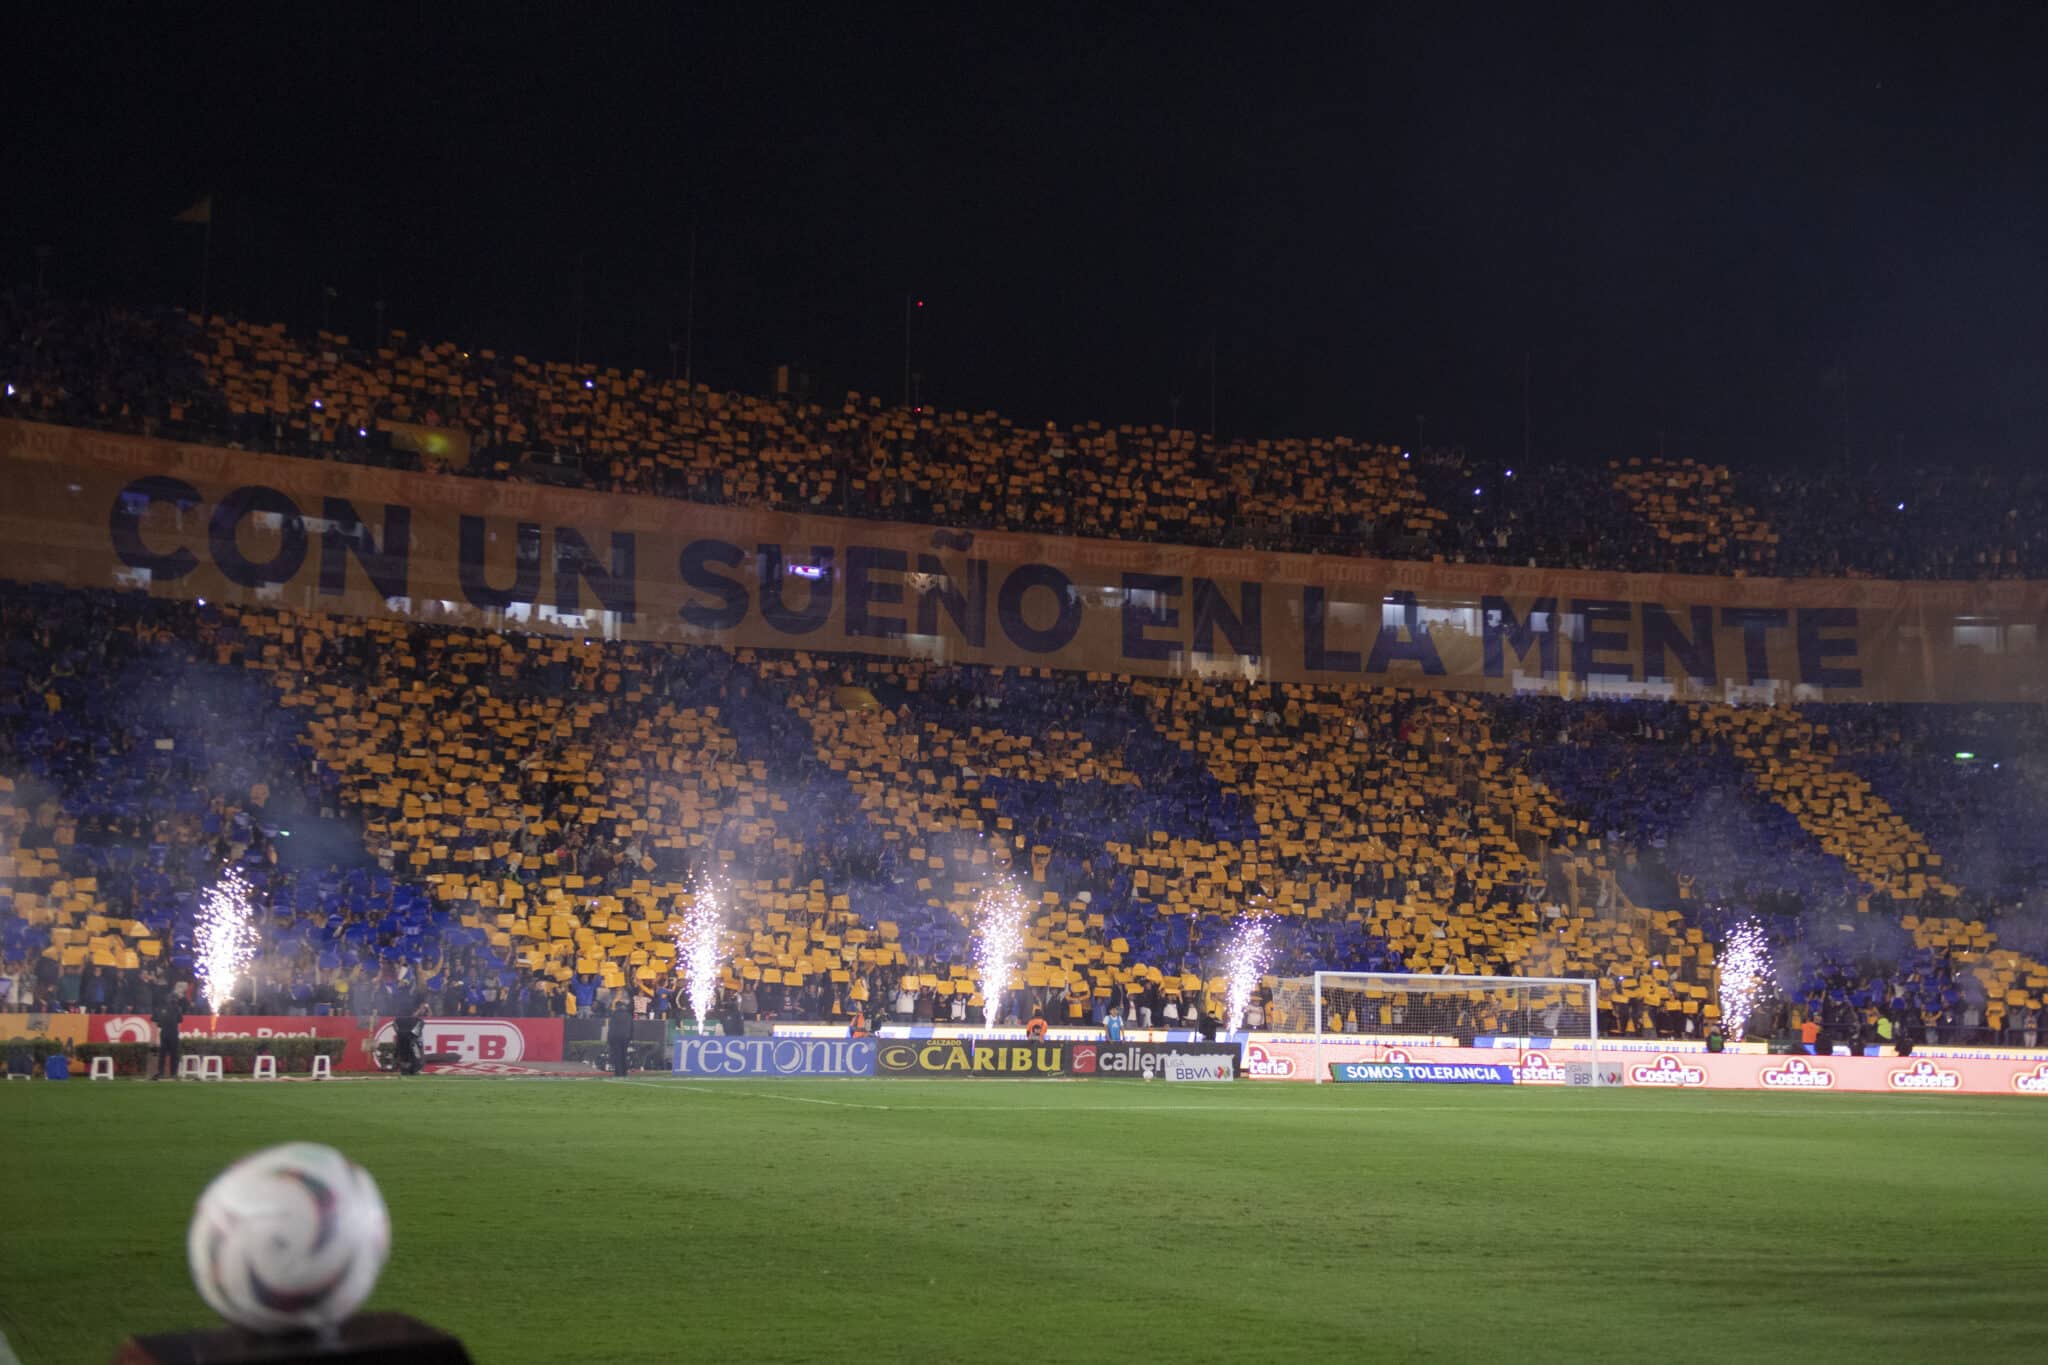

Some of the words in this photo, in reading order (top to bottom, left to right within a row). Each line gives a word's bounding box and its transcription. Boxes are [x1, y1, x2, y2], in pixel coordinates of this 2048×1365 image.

[110, 476, 409, 600] CON
[459, 514, 635, 625] UN
[679, 530, 1082, 654] SUEÑO
[1122, 571, 1262, 661] EN
[1303, 586, 1446, 677] LA
[1481, 594, 1862, 688] MENTE
[918, 1046, 1061, 1072] CARIBU
[1389, 1051, 1405, 1063] La
[1527, 1055, 1543, 1067] La
[1659, 1058, 1676, 1070] La
[1346, 1065, 1404, 1079] SOMOS
[1405, 1065, 1501, 1081] TOLERANCIA
[1510, 1065, 1566, 1080] osteña
[1789, 1060, 1805, 1071] La
[1916, 1062, 1932, 1074] La
[1176, 1068, 1211, 1080] BBVA
[1634, 1067, 1701, 1084] Costeña
[1765, 1070, 1829, 1086] Costeña
[1893, 1072, 1957, 1088] Costeña
